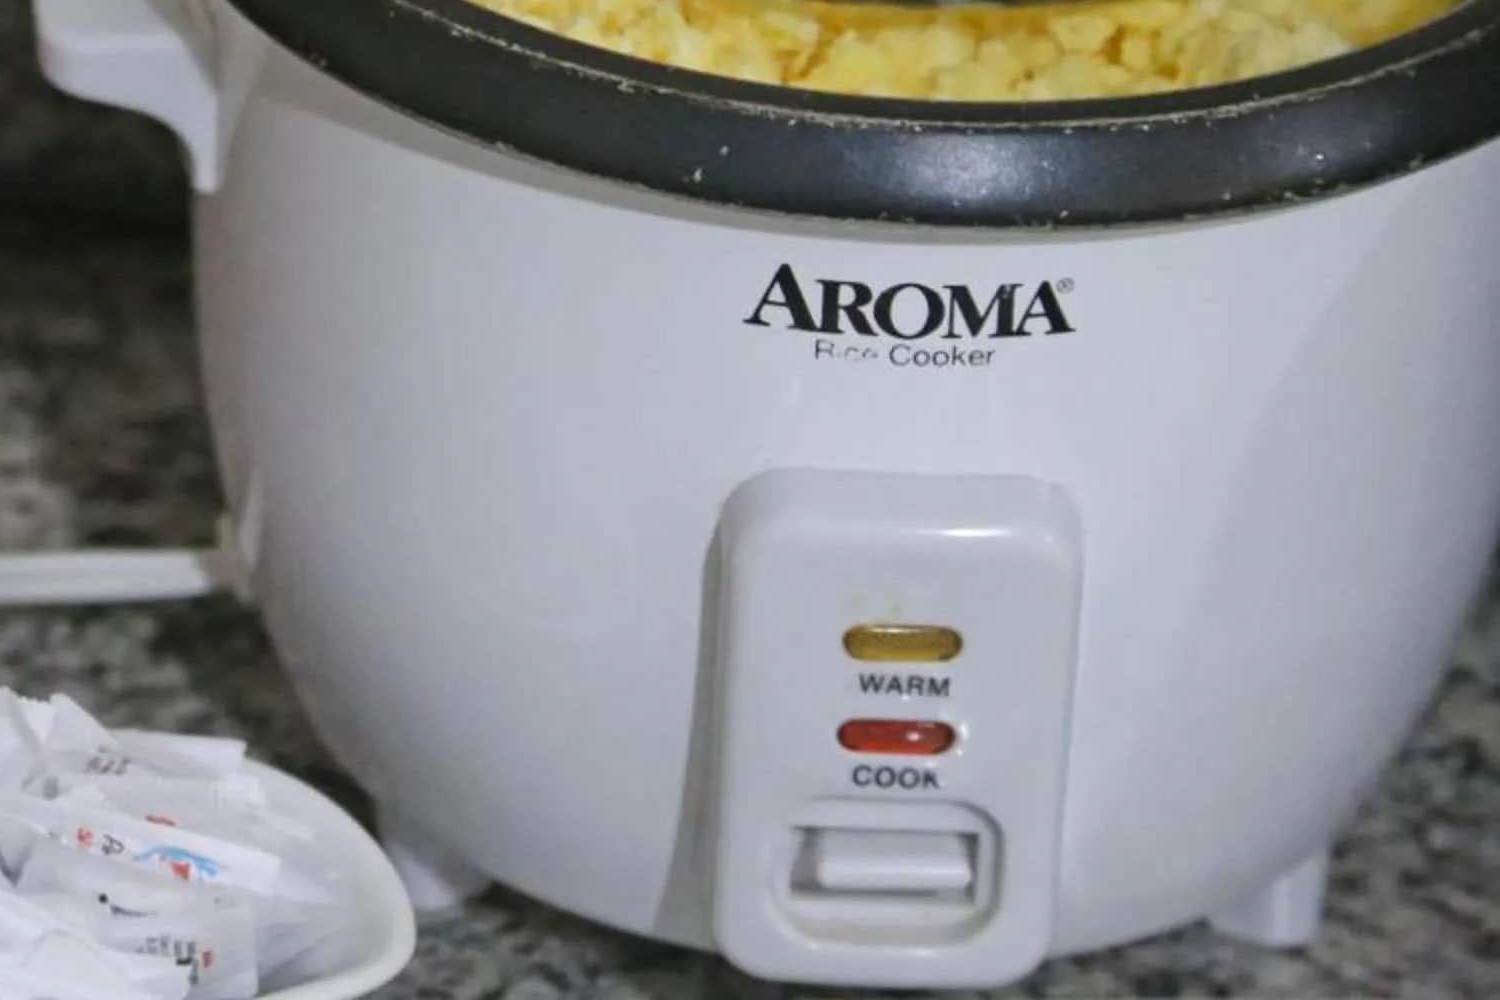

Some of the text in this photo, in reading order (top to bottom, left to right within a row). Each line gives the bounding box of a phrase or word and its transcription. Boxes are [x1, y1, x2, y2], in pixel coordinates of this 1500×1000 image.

[814, 339, 996, 367] Rce Cooker
[859, 673, 950, 697] WARM
[851, 765, 940, 790] COOK
